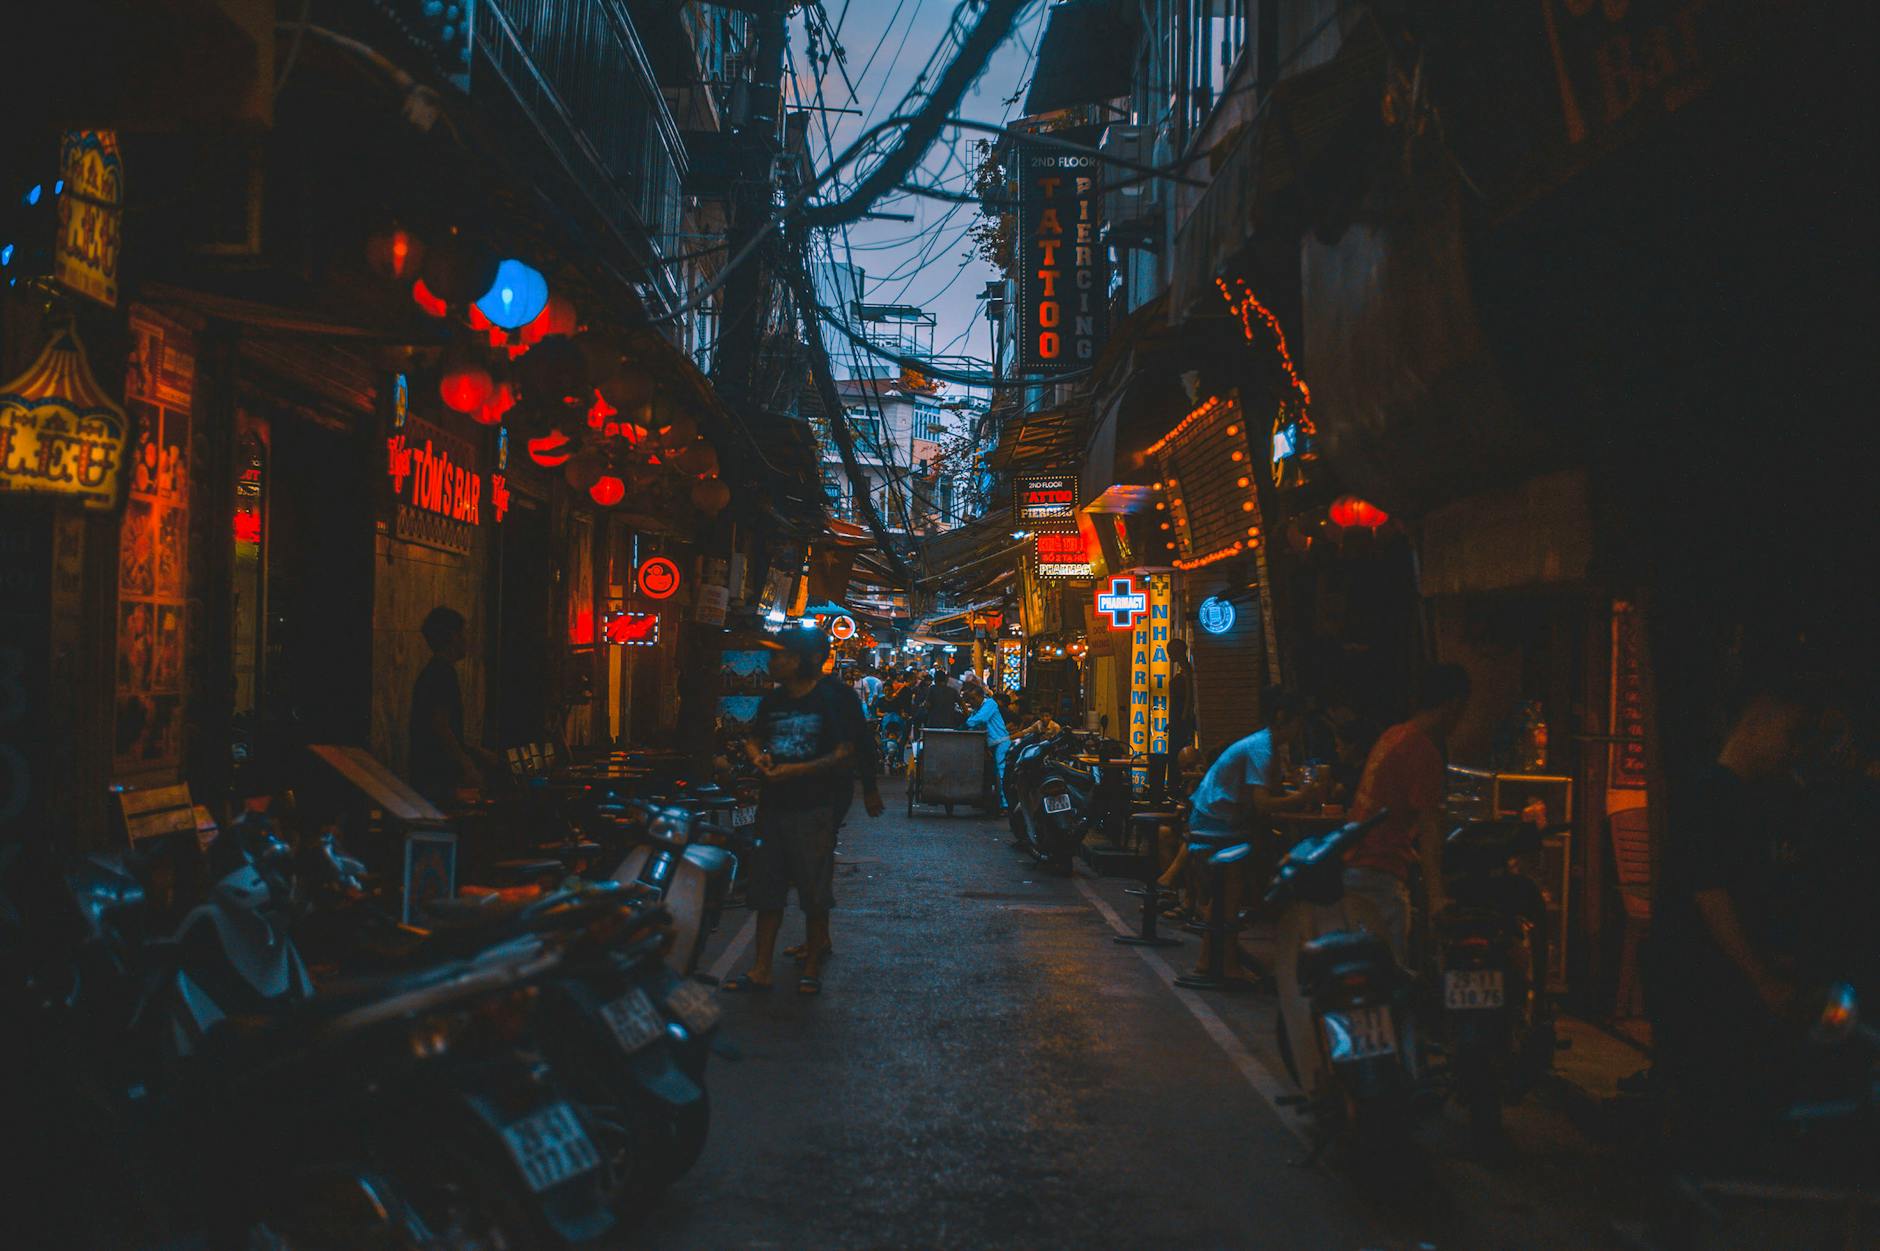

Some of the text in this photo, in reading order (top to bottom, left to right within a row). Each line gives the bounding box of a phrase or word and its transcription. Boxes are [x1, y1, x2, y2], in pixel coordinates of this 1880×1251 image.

[1031, 157, 1096, 168] 2ND FLOOR
[1038, 177, 1063, 359] TATTOO
[1075, 177, 1093, 359] PIERCING
[1028, 481, 1063, 489] 2ND FLOOR
[453, 466, 481, 526] BAR
[1023, 490, 1073, 503] TATTOO
[1101, 596, 1144, 610] PHARMACY
